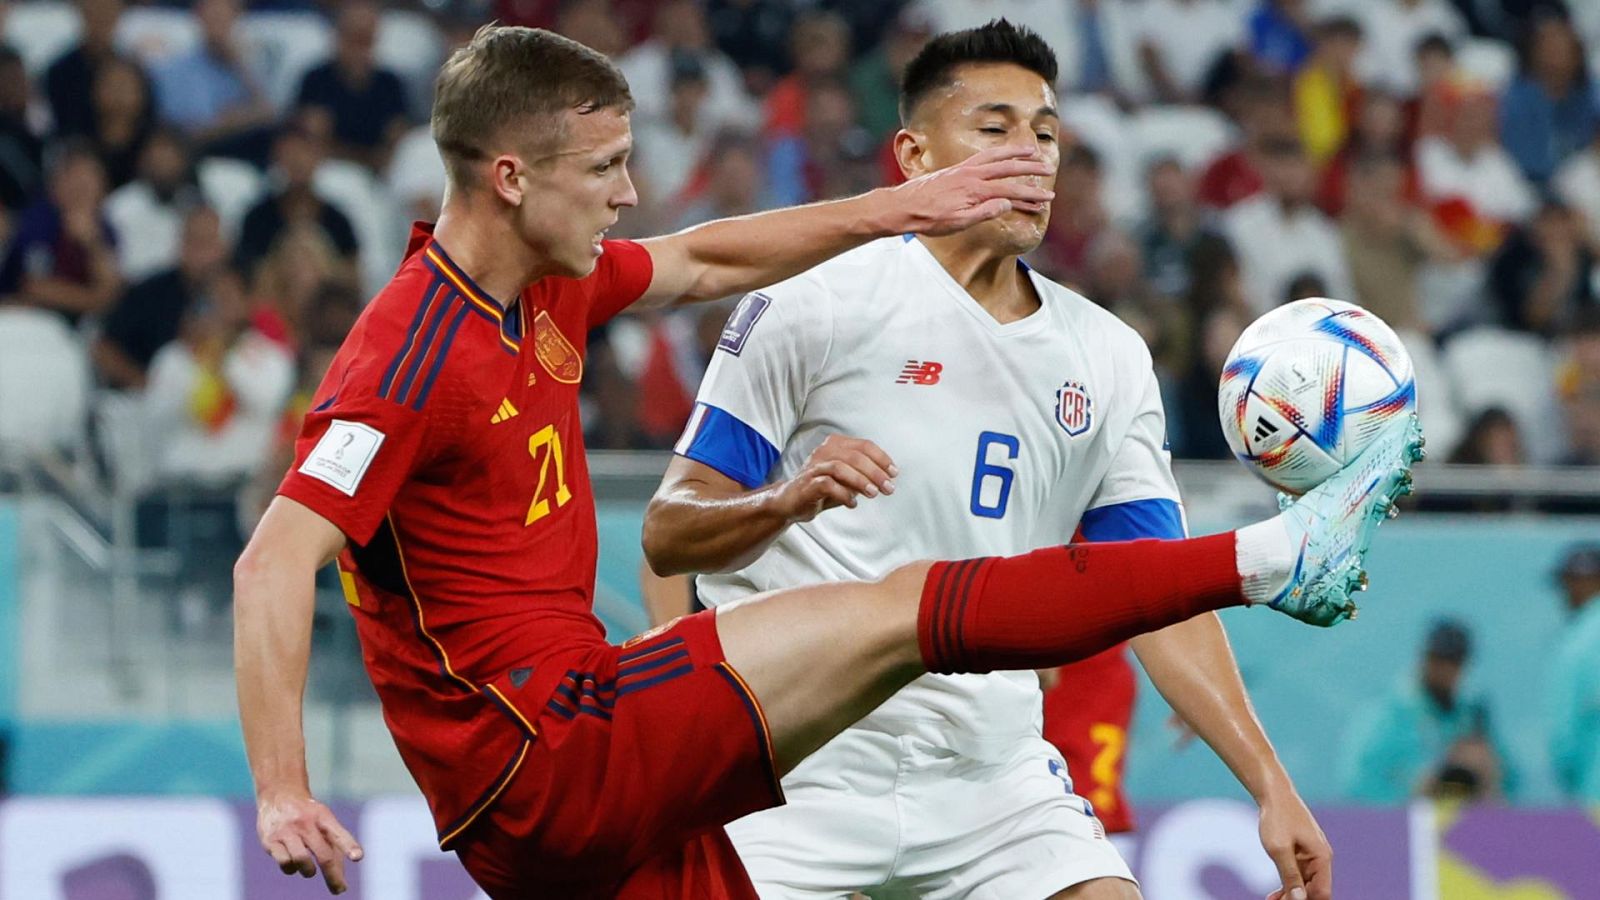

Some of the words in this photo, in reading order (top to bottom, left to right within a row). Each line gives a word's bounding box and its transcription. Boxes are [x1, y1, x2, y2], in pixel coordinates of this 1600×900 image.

[895, 360, 943, 385] NB
[1063, 390, 1084, 429] CR
[525, 424, 572, 527] 21
[970, 430, 1020, 520] 6
